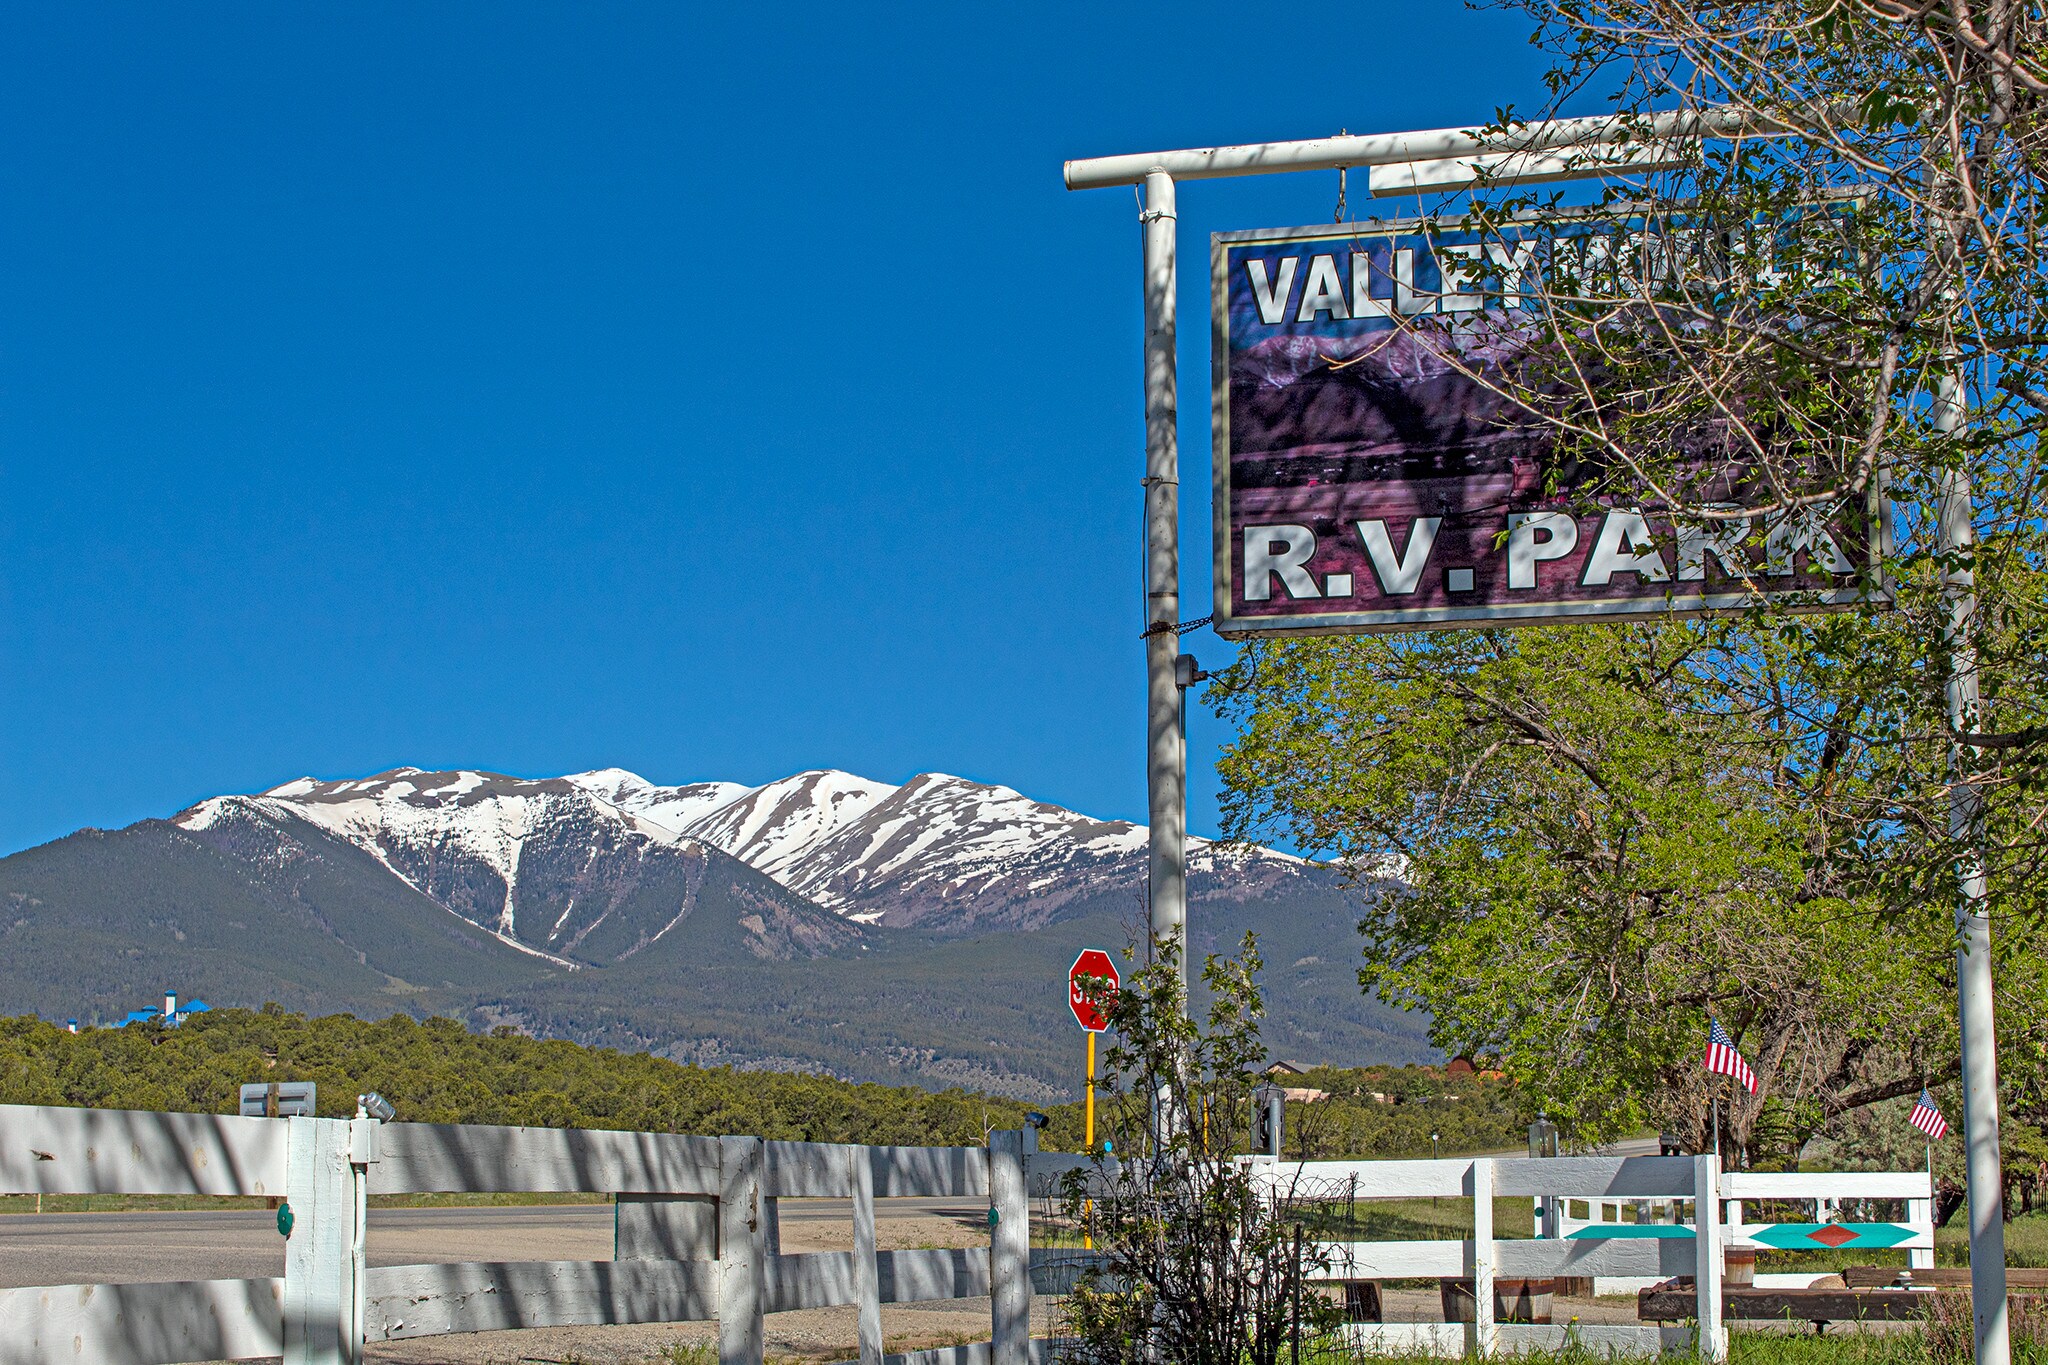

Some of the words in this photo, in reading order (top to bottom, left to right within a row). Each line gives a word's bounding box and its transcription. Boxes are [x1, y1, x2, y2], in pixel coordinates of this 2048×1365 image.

[1245, 239, 1538, 325] VALLEY
[1244, 516, 1474, 601] R.V.
[1508, 500, 1855, 589] PARK
[1073, 974, 1117, 1004] SP
